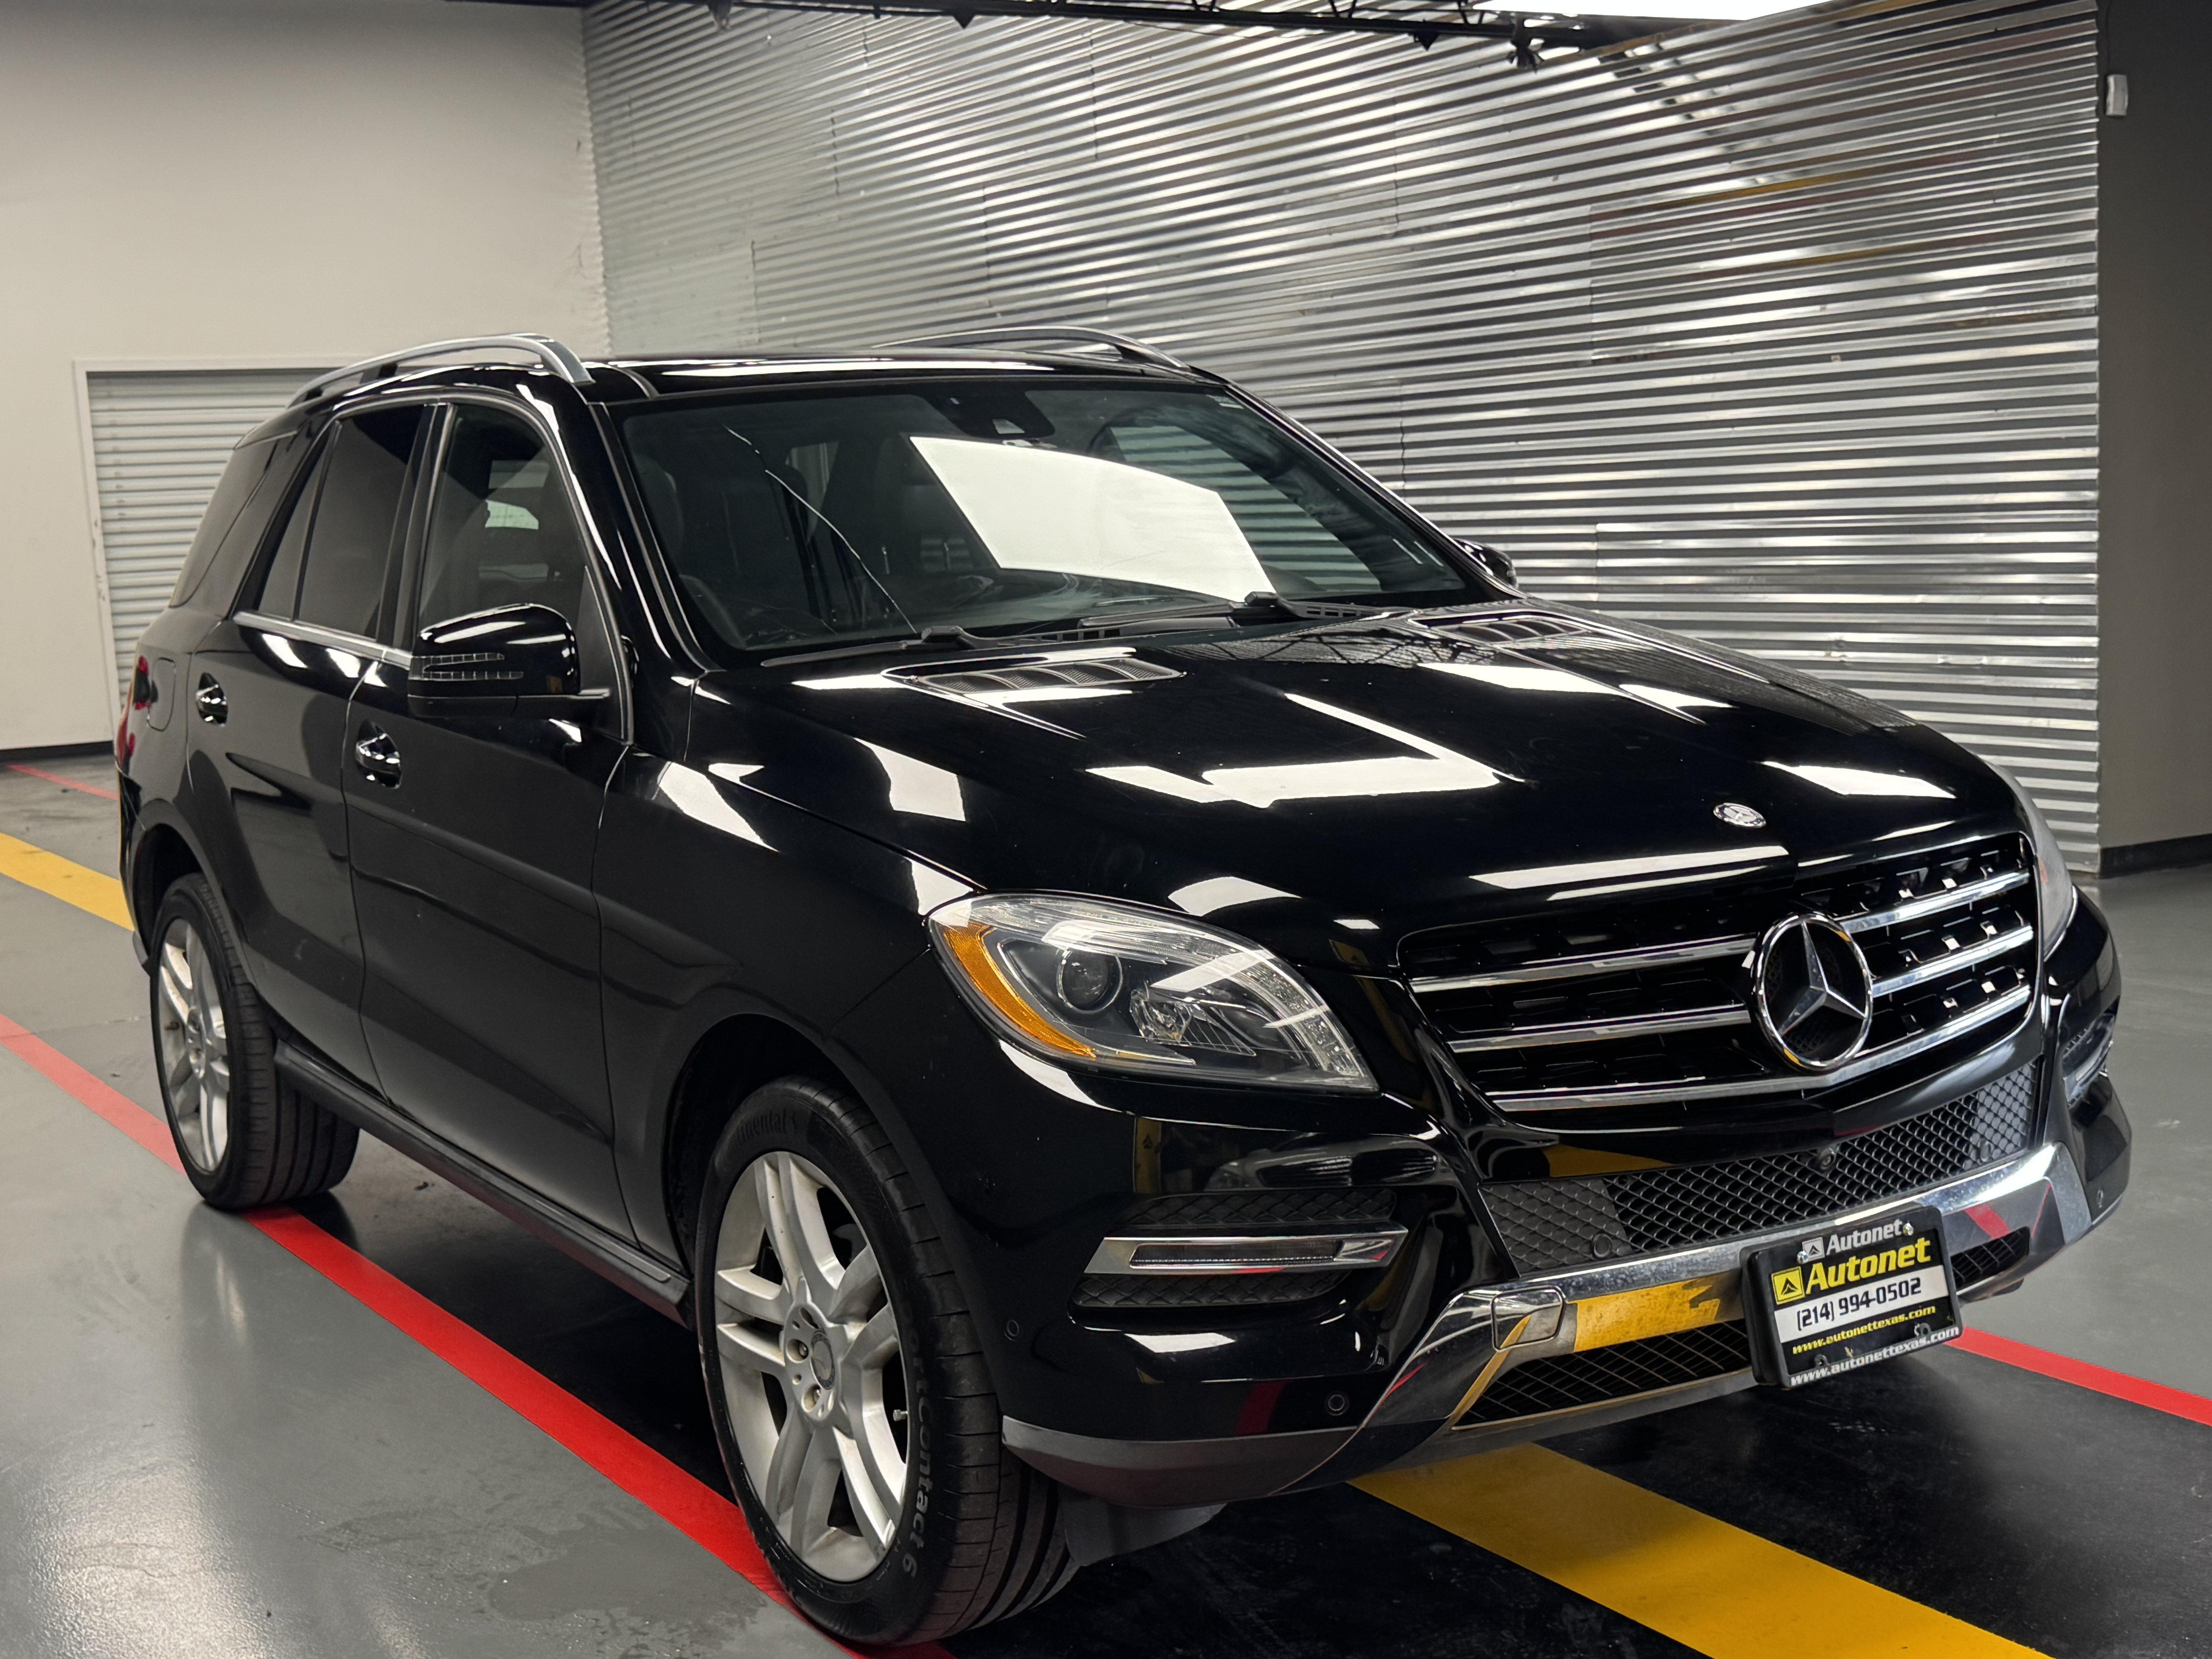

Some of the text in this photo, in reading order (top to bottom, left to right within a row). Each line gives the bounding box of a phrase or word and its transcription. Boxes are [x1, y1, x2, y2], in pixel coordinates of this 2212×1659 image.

[1826, 1218, 1902, 1255] Autonet
[1806, 1237, 1931, 1295] Autonet
[1797, 1277, 1922, 1331] (214) 994-0502
[1792, 1306, 1936, 1354] www.autonettexas.com
[1790, 1326, 1959, 1386] www.autonettexas.com
[902, 1553, 917, 1577] 6
